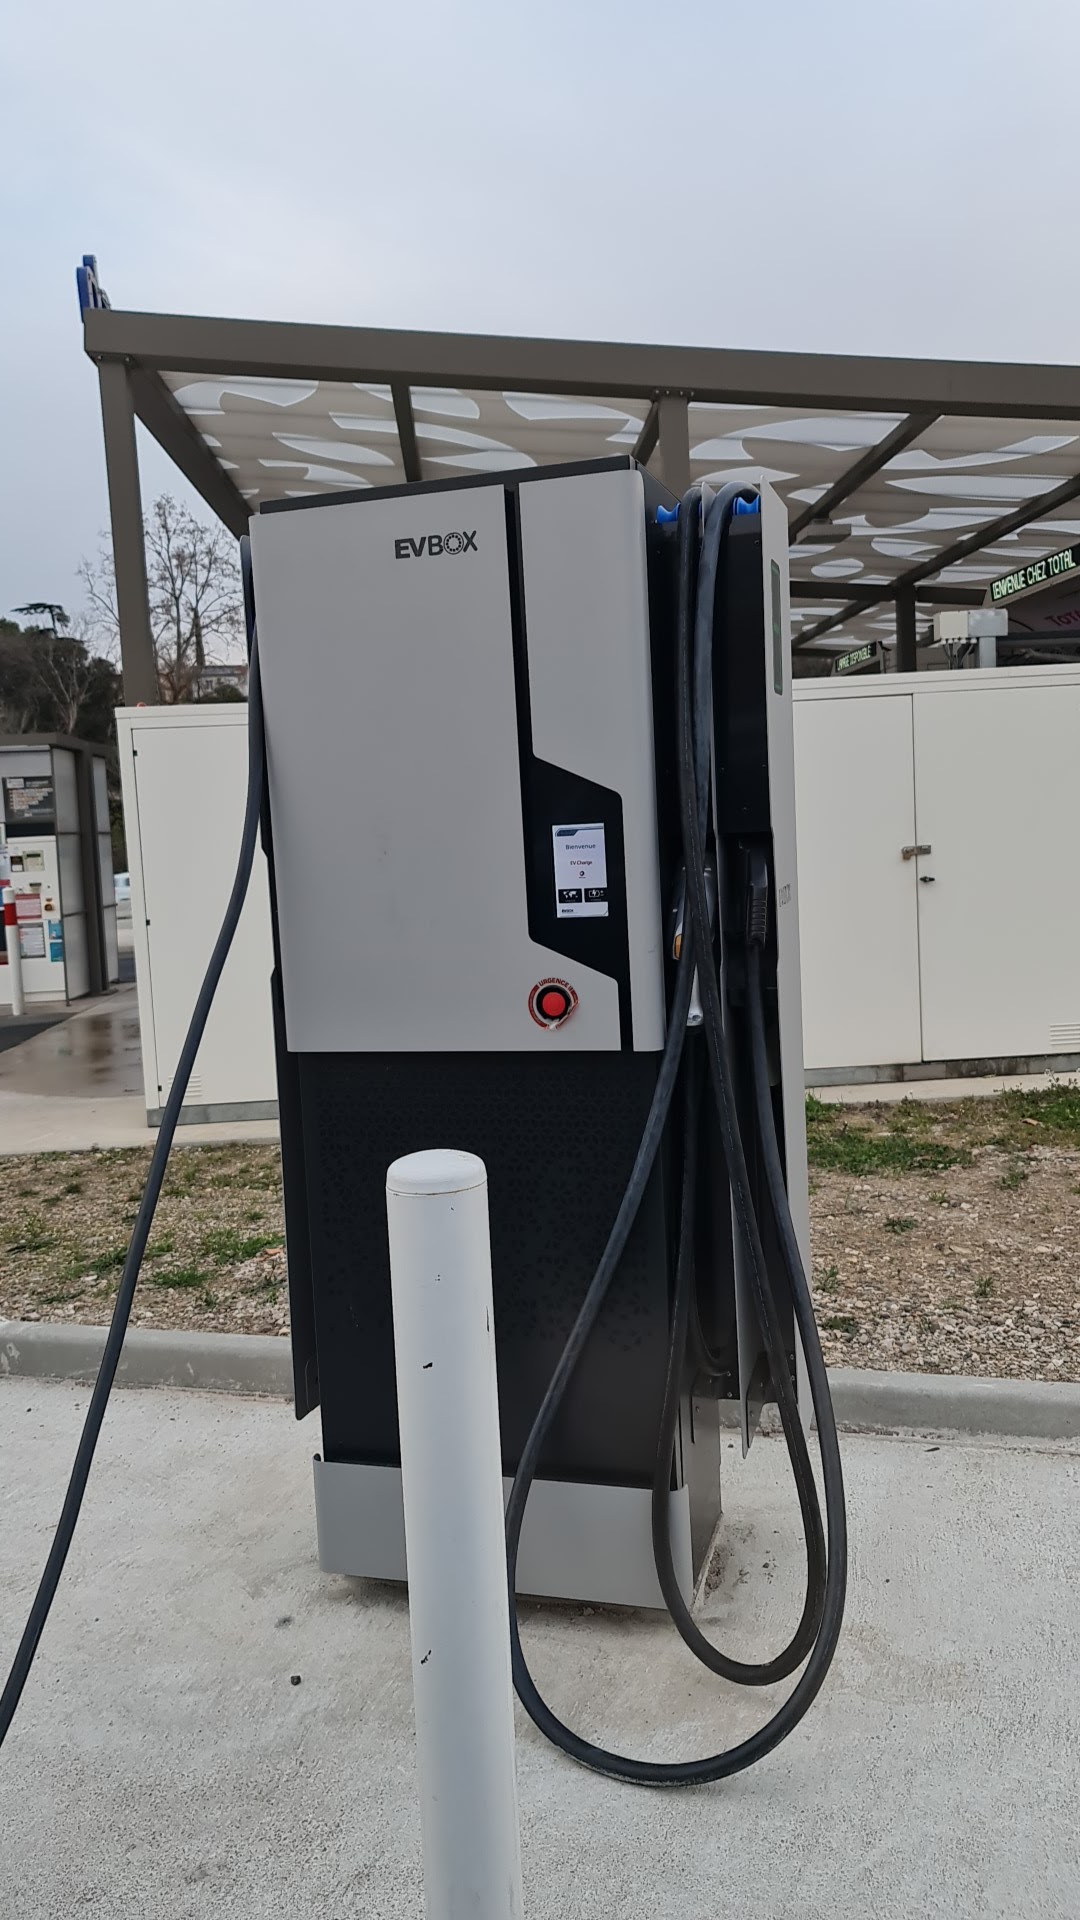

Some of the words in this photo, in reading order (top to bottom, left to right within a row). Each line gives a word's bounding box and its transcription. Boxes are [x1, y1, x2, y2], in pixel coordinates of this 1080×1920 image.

[394, 530, 478, 559] EVBOX
[1026, 561, 1047, 585] CHEZ
[1047, 549, 1076, 576] TOTAL
[538, 977, 570, 988] URGENCE
